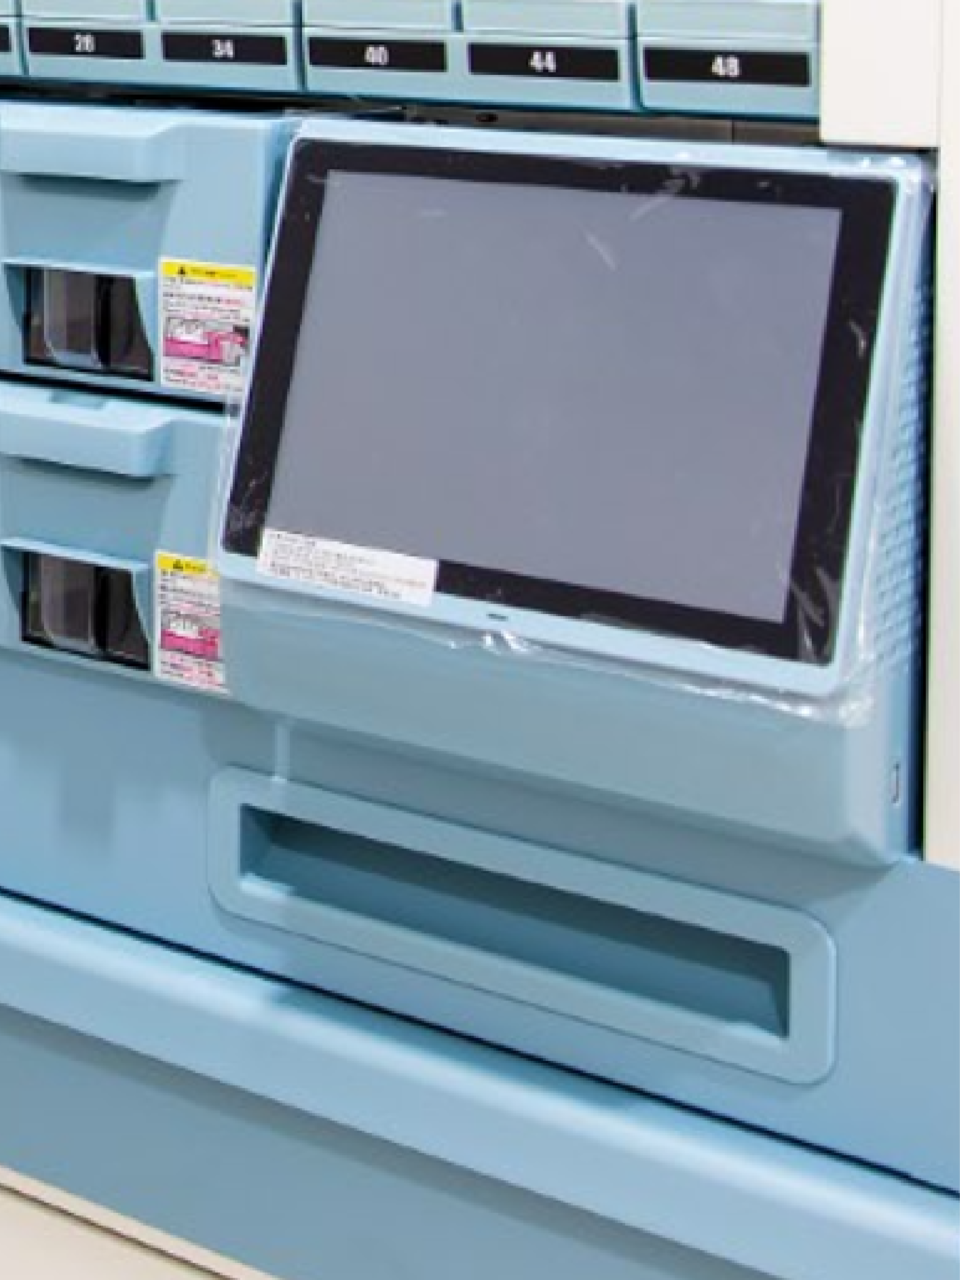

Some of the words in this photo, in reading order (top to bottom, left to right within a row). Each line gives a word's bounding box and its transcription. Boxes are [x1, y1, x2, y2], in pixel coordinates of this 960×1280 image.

[364, 46, 388, 66] 40
[529, 51, 556, 72] 44
[712, 56, 740, 76] 48
